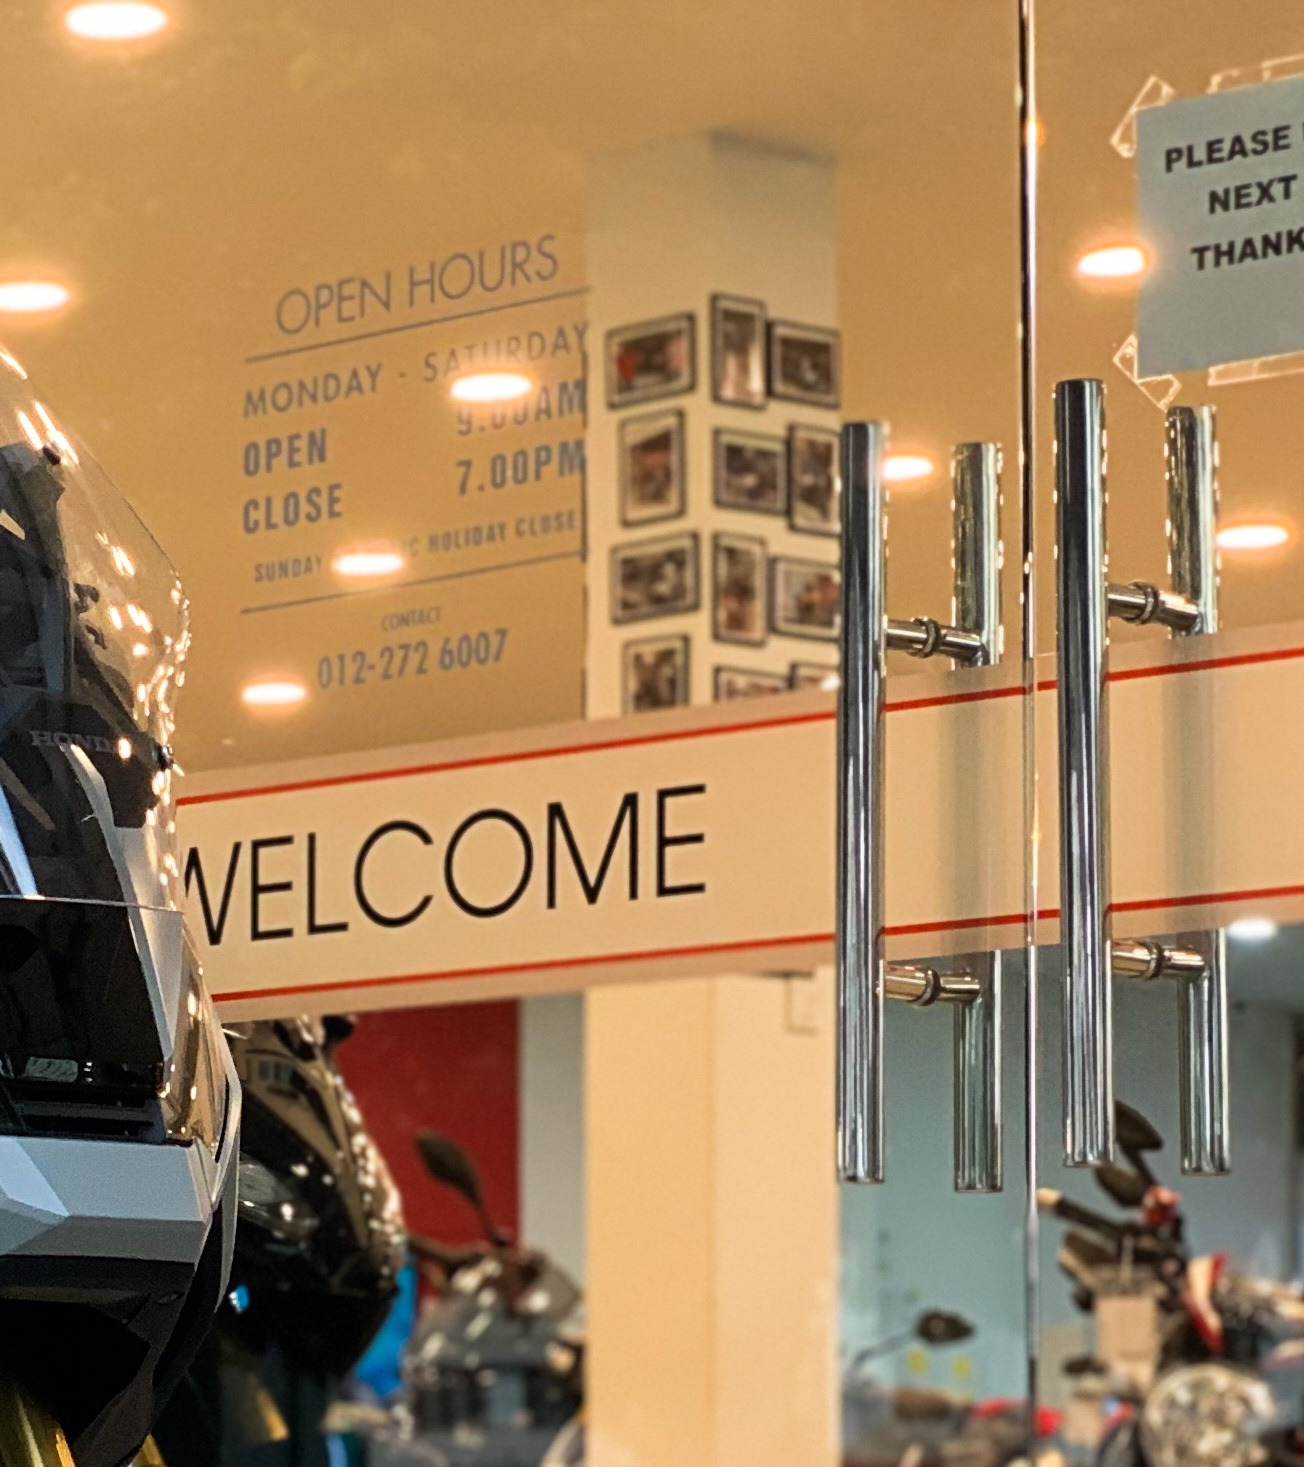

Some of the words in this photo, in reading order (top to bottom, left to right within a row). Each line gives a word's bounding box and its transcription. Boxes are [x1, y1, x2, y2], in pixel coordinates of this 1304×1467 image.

[1164, 124, 1292, 174] PLEASE
[1207, 174, 1298, 215] NEXT
[1190, 227, 1304, 271] THANK
[275, 271, 392, 336] OPEN
[407, 234, 560, 309] HOURS
[243, 363, 383, 419] MONDAY
[423, 321, 588, 383] SATURDAY
[242, 428, 328, 477] OPEN
[242, 483, 344, 535] CLOSE
[456, 439, 586, 497] 7.00PM
[253, 555, 324, 583] SUNDAY
[428, 521, 507, 554] HOLIDAY
[514, 509, 577, 539] CLOSE
[381, 606, 442, 632] CONTACT
[317, 641, 429, 690] 012-272
[439, 628, 509, 672] 6007
[29, 730, 134, 755] HOND
